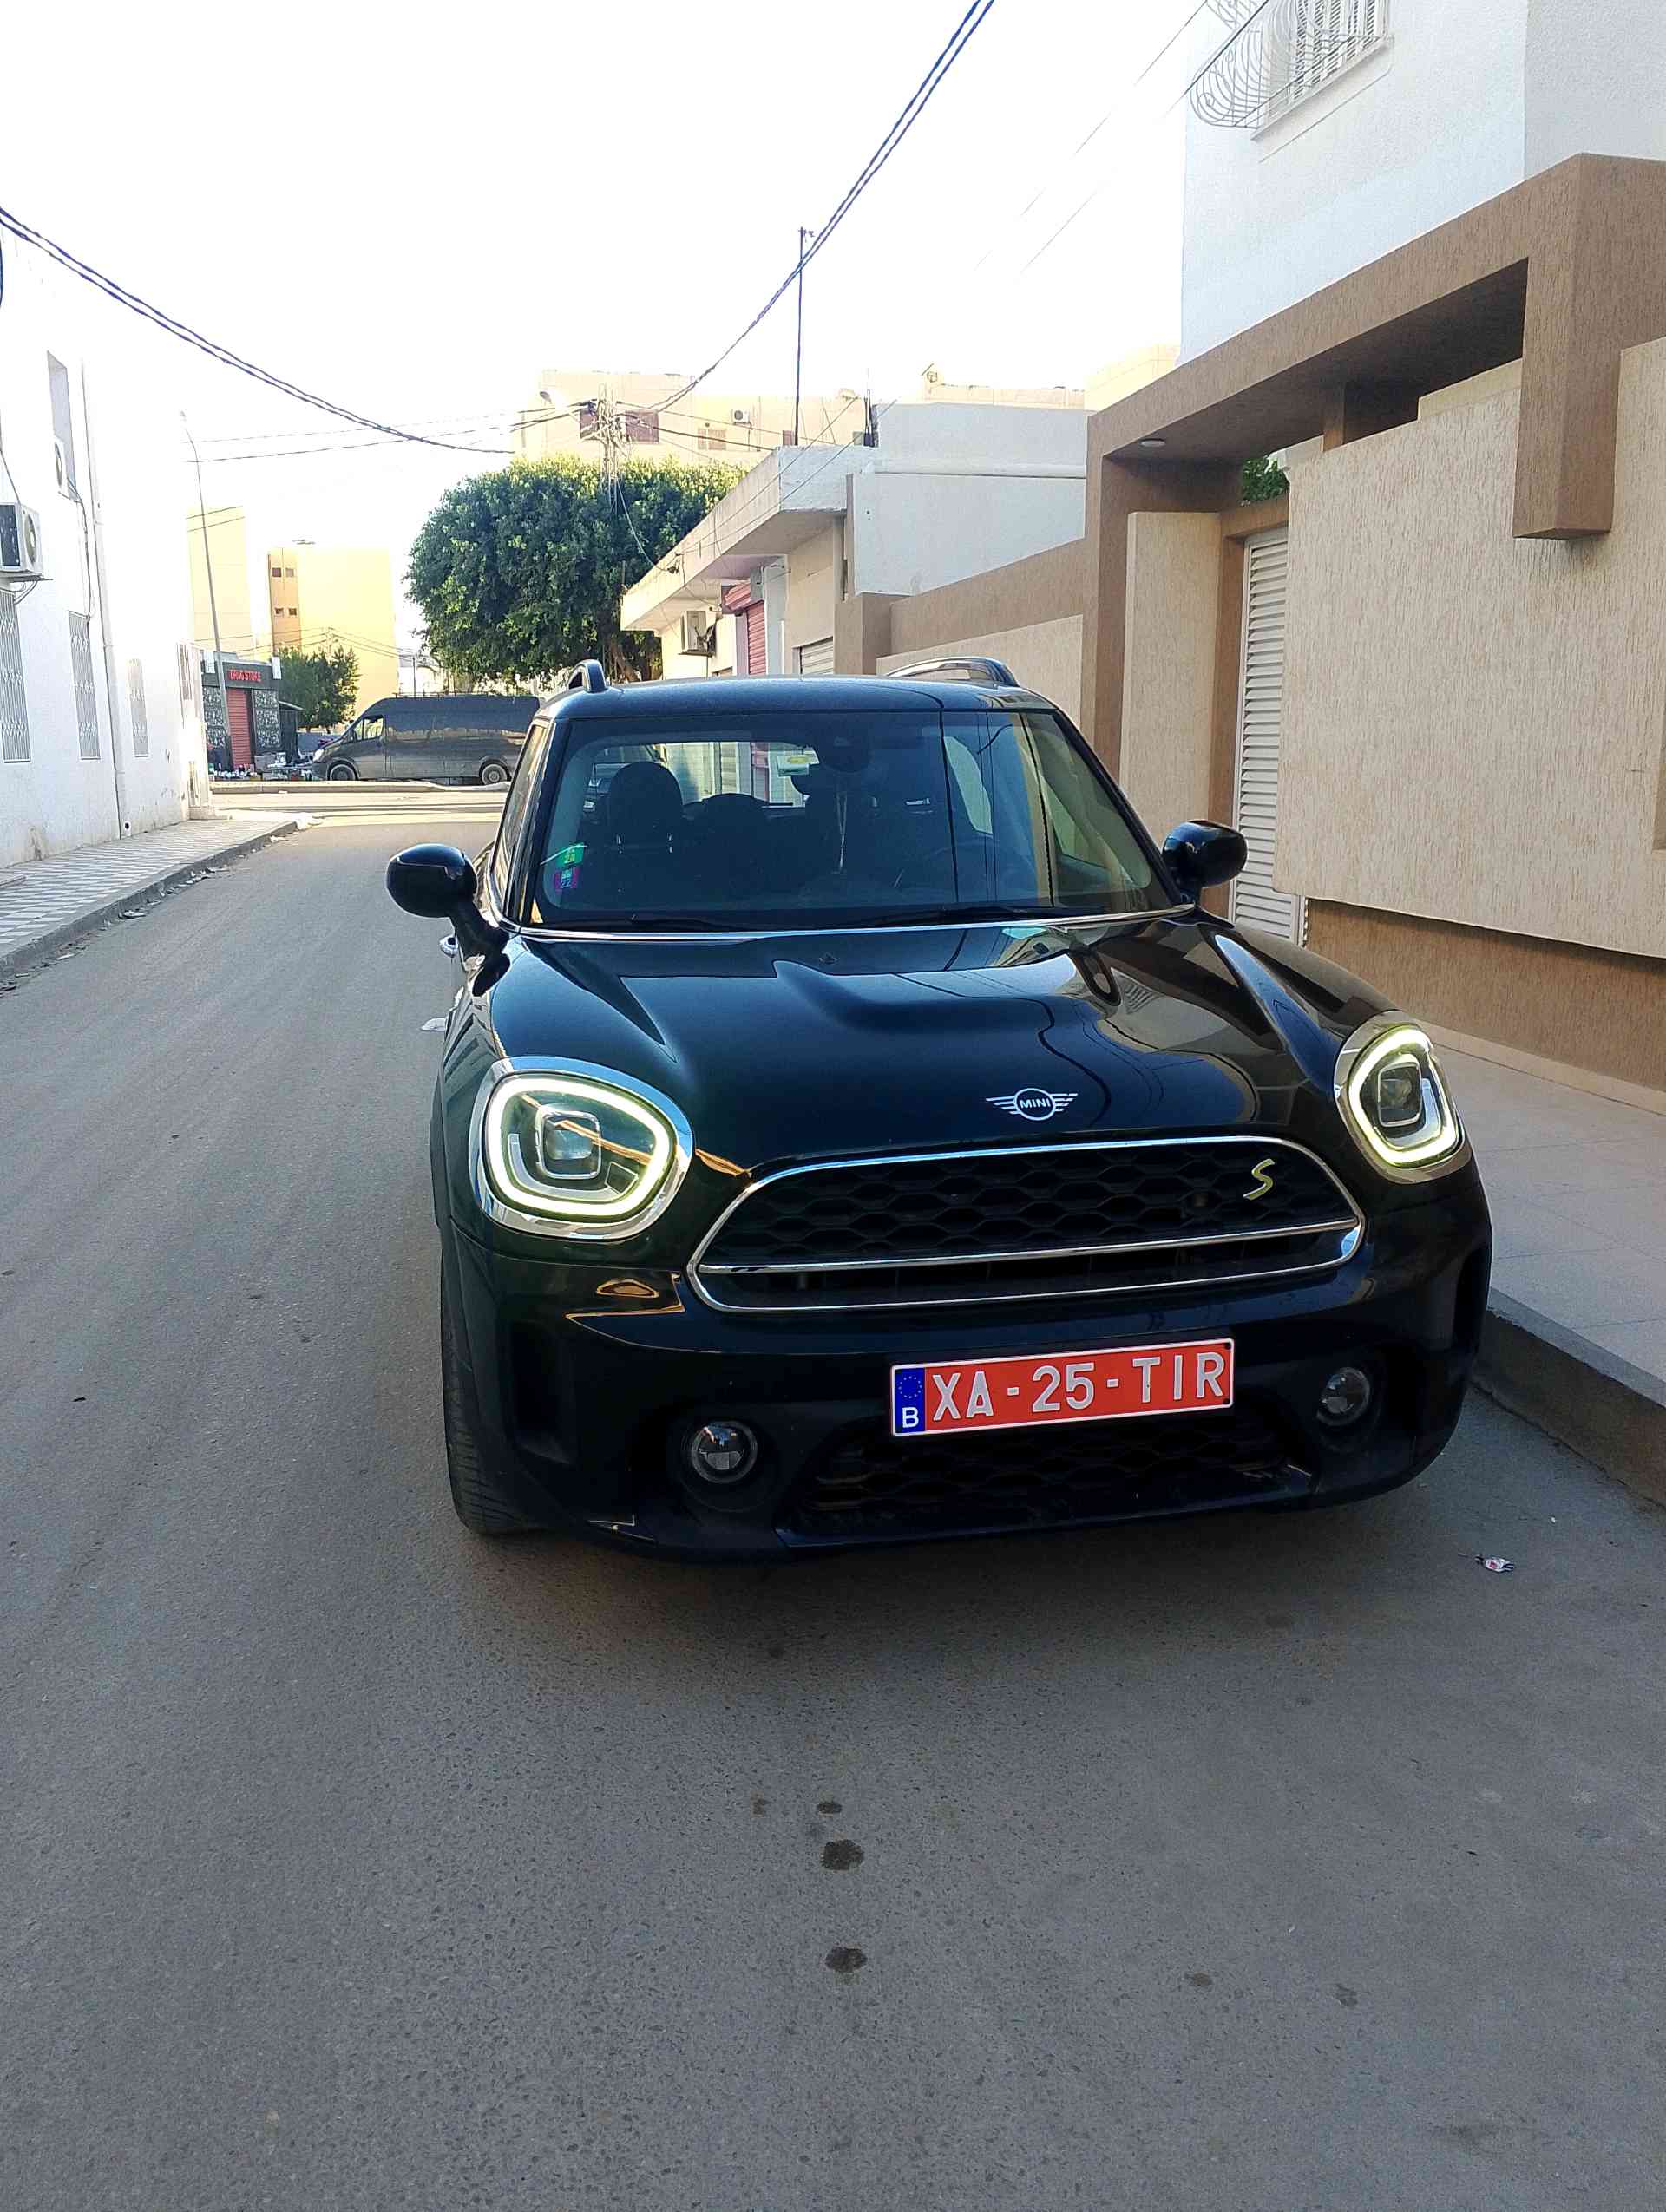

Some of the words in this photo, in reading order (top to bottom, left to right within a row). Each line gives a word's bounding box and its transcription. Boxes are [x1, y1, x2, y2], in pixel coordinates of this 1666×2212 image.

[1020, 1097, 1051, 1109] MINI
[1243, 1159, 1275, 1200] S
[902, 1406, 920, 1429] B
